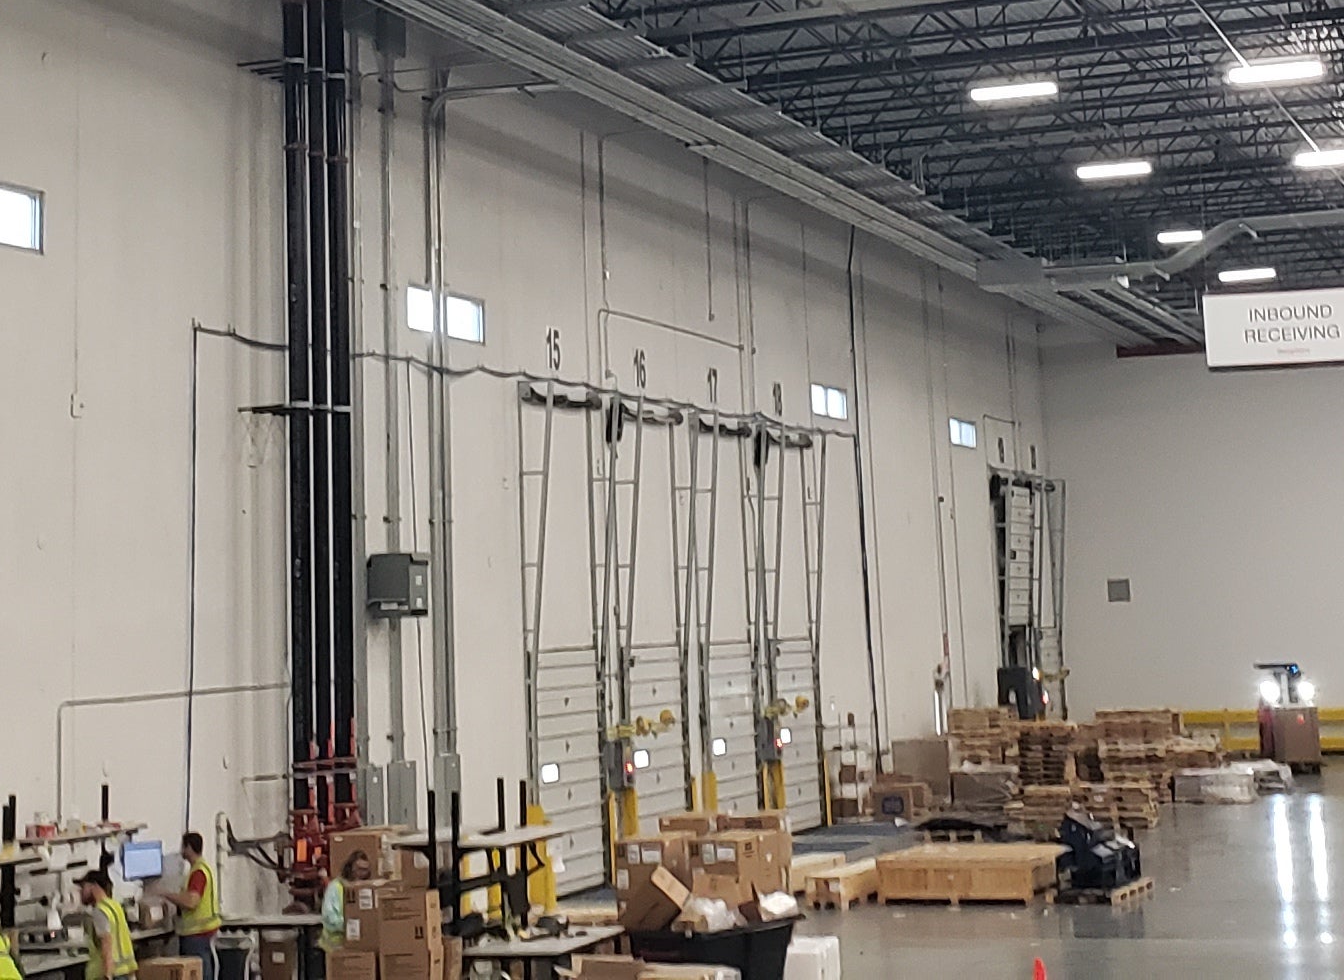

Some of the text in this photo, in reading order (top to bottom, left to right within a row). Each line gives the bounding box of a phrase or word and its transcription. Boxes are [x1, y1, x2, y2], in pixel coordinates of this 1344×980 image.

[1248, 303, 1334, 323] INBOUND
[546, 327, 561, 371] 15
[1243, 323, 1342, 345] RECEIVING
[633, 348, 647, 389] 16
[707, 368, 718, 403] 17
